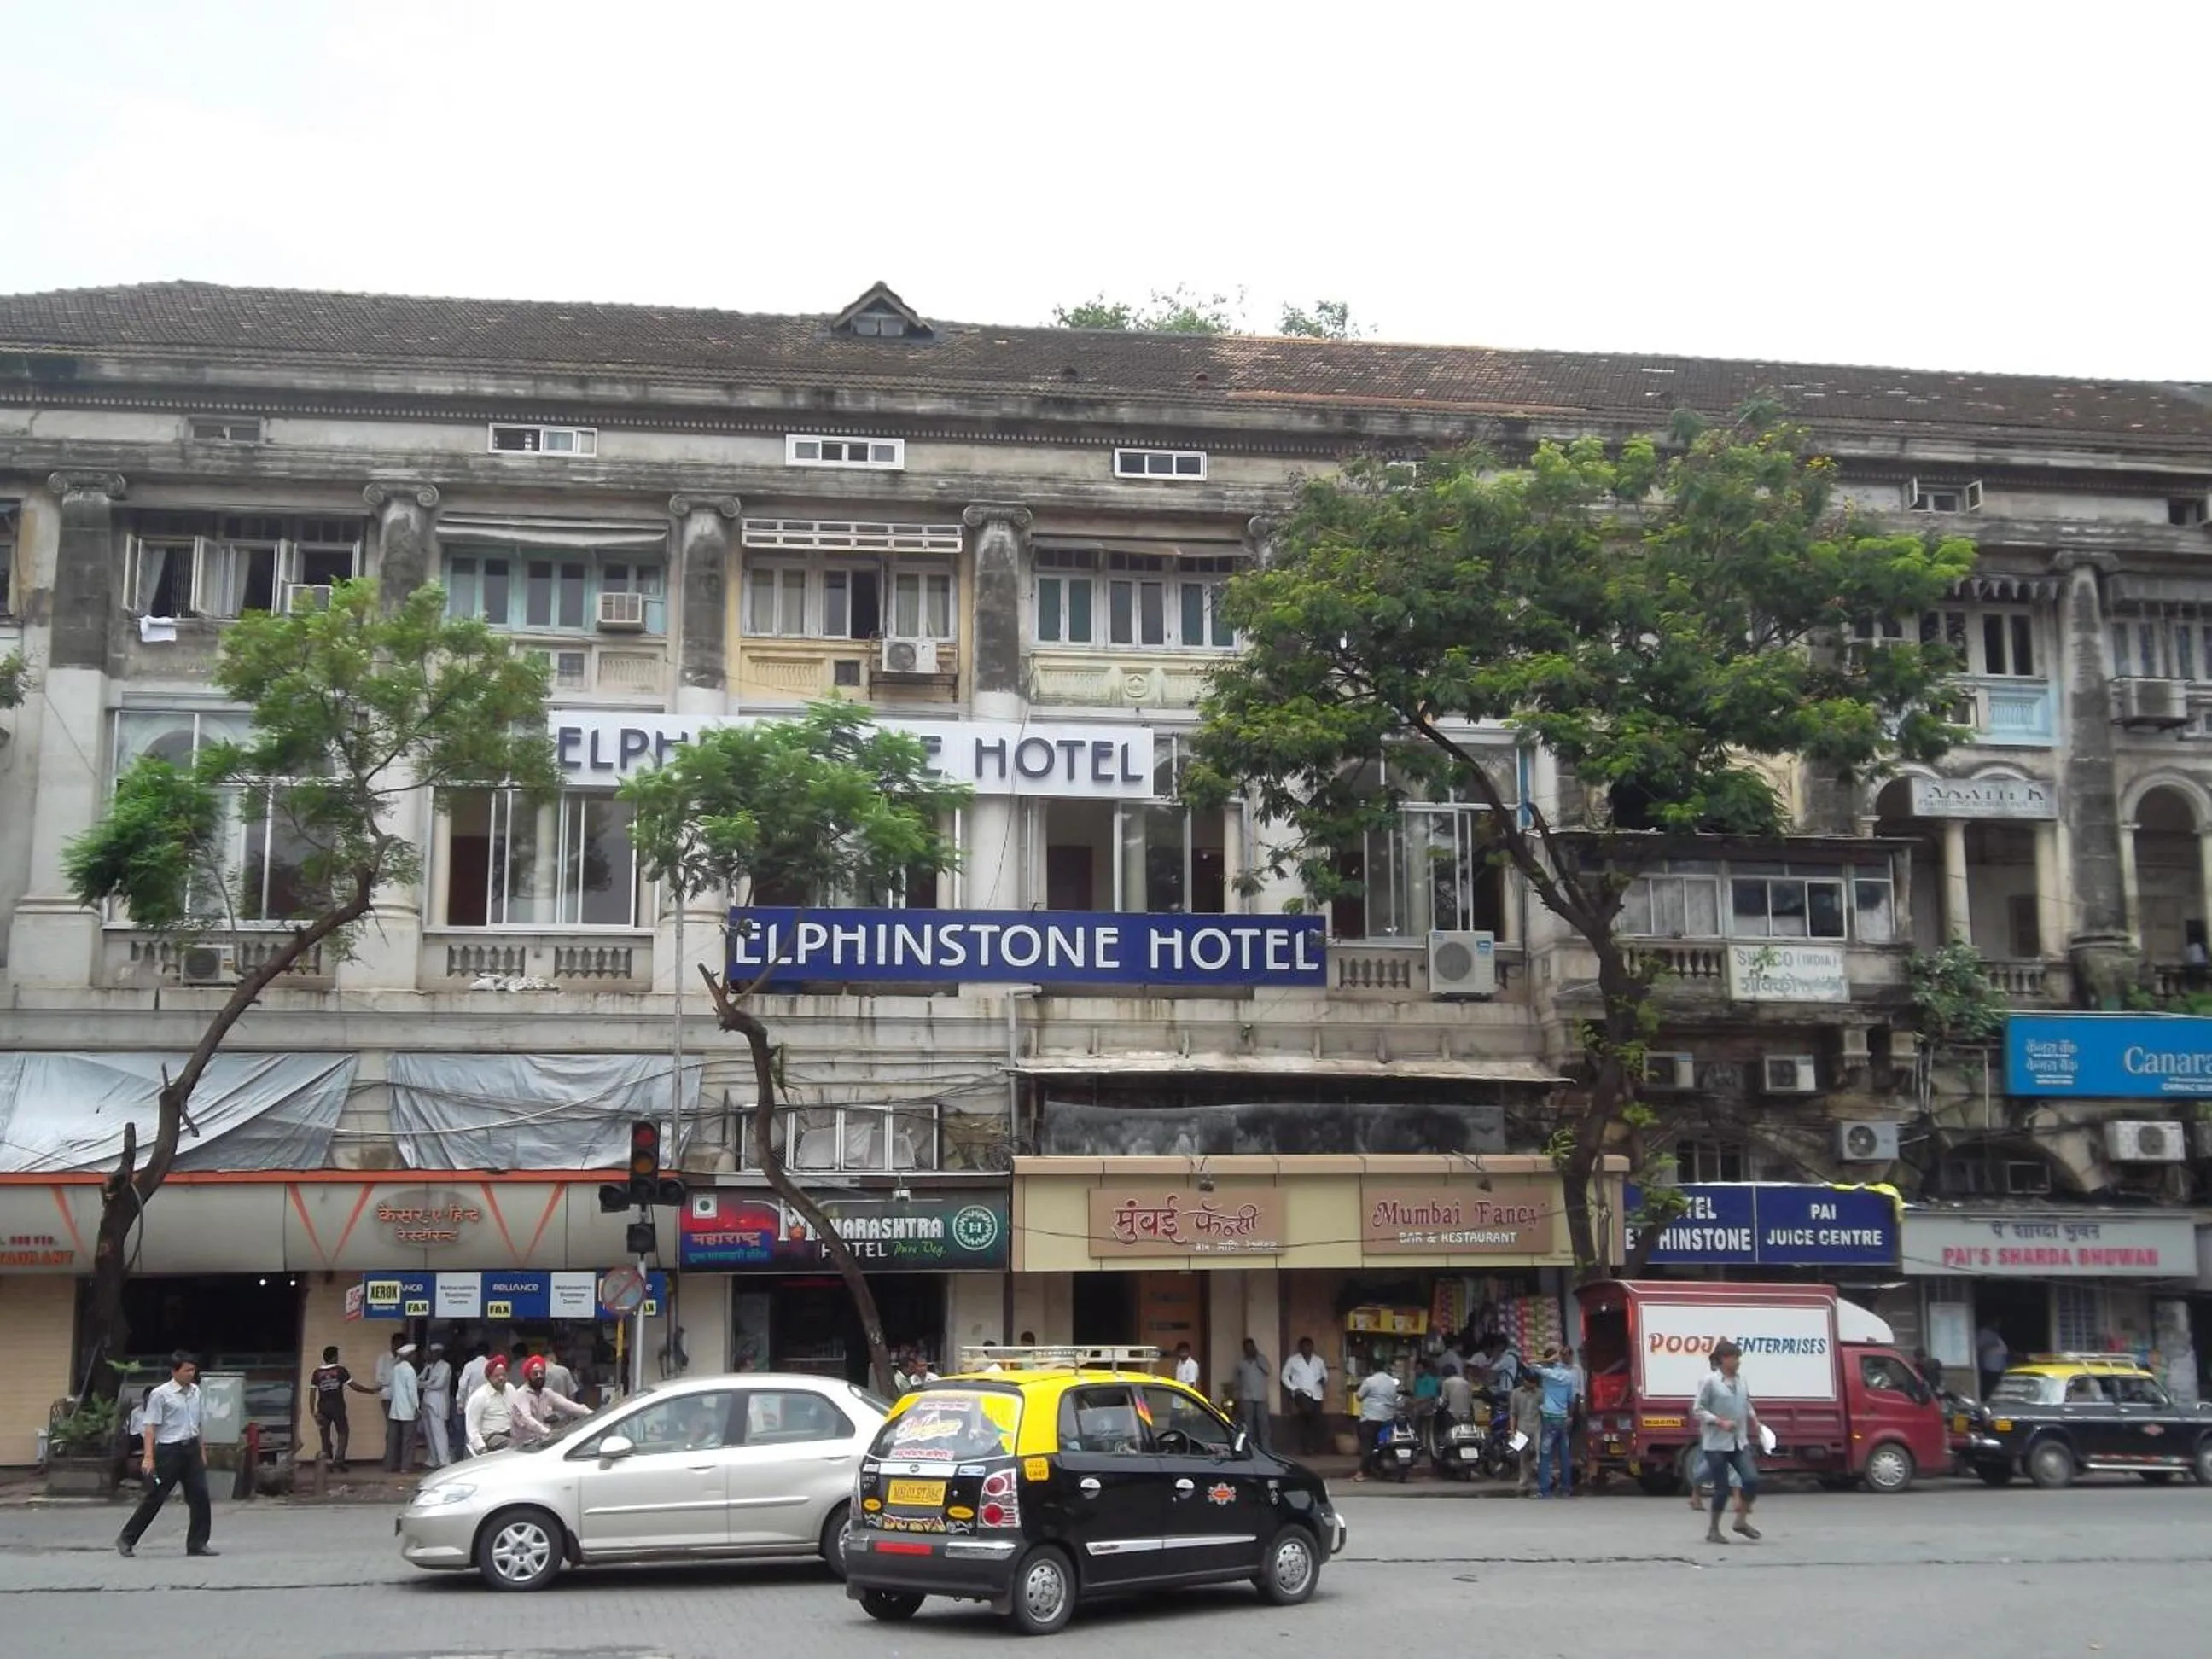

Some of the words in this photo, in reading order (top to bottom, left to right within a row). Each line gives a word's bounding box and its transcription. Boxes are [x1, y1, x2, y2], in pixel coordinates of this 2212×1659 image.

[975, 736, 1144, 782] HOTEL
[736, 923, 1120, 969] ELPHINSTONE
[1150, 928, 1319, 970] HOTEL
[1111, 1195, 1187, 1245] मुंबई
[1372, 1200, 1461, 1227] Mumbai
[1811, 1204, 1837, 1220] PAI
[1441, 1231, 1517, 1243] RESTAURANT
[1767, 1230, 1813, 1245] JUICE
[1819, 1230, 1883, 1246] CENTRE
[821, 1242, 888, 1258] HTEL
[370, 1285, 399, 1301] XEROX
[407, 1302, 428, 1313] FAX
[489, 1304, 510, 1315] FAX
[1649, 1333, 1719, 1353] POOJ
[1736, 1336, 1826, 1355] ENTERPRISES
